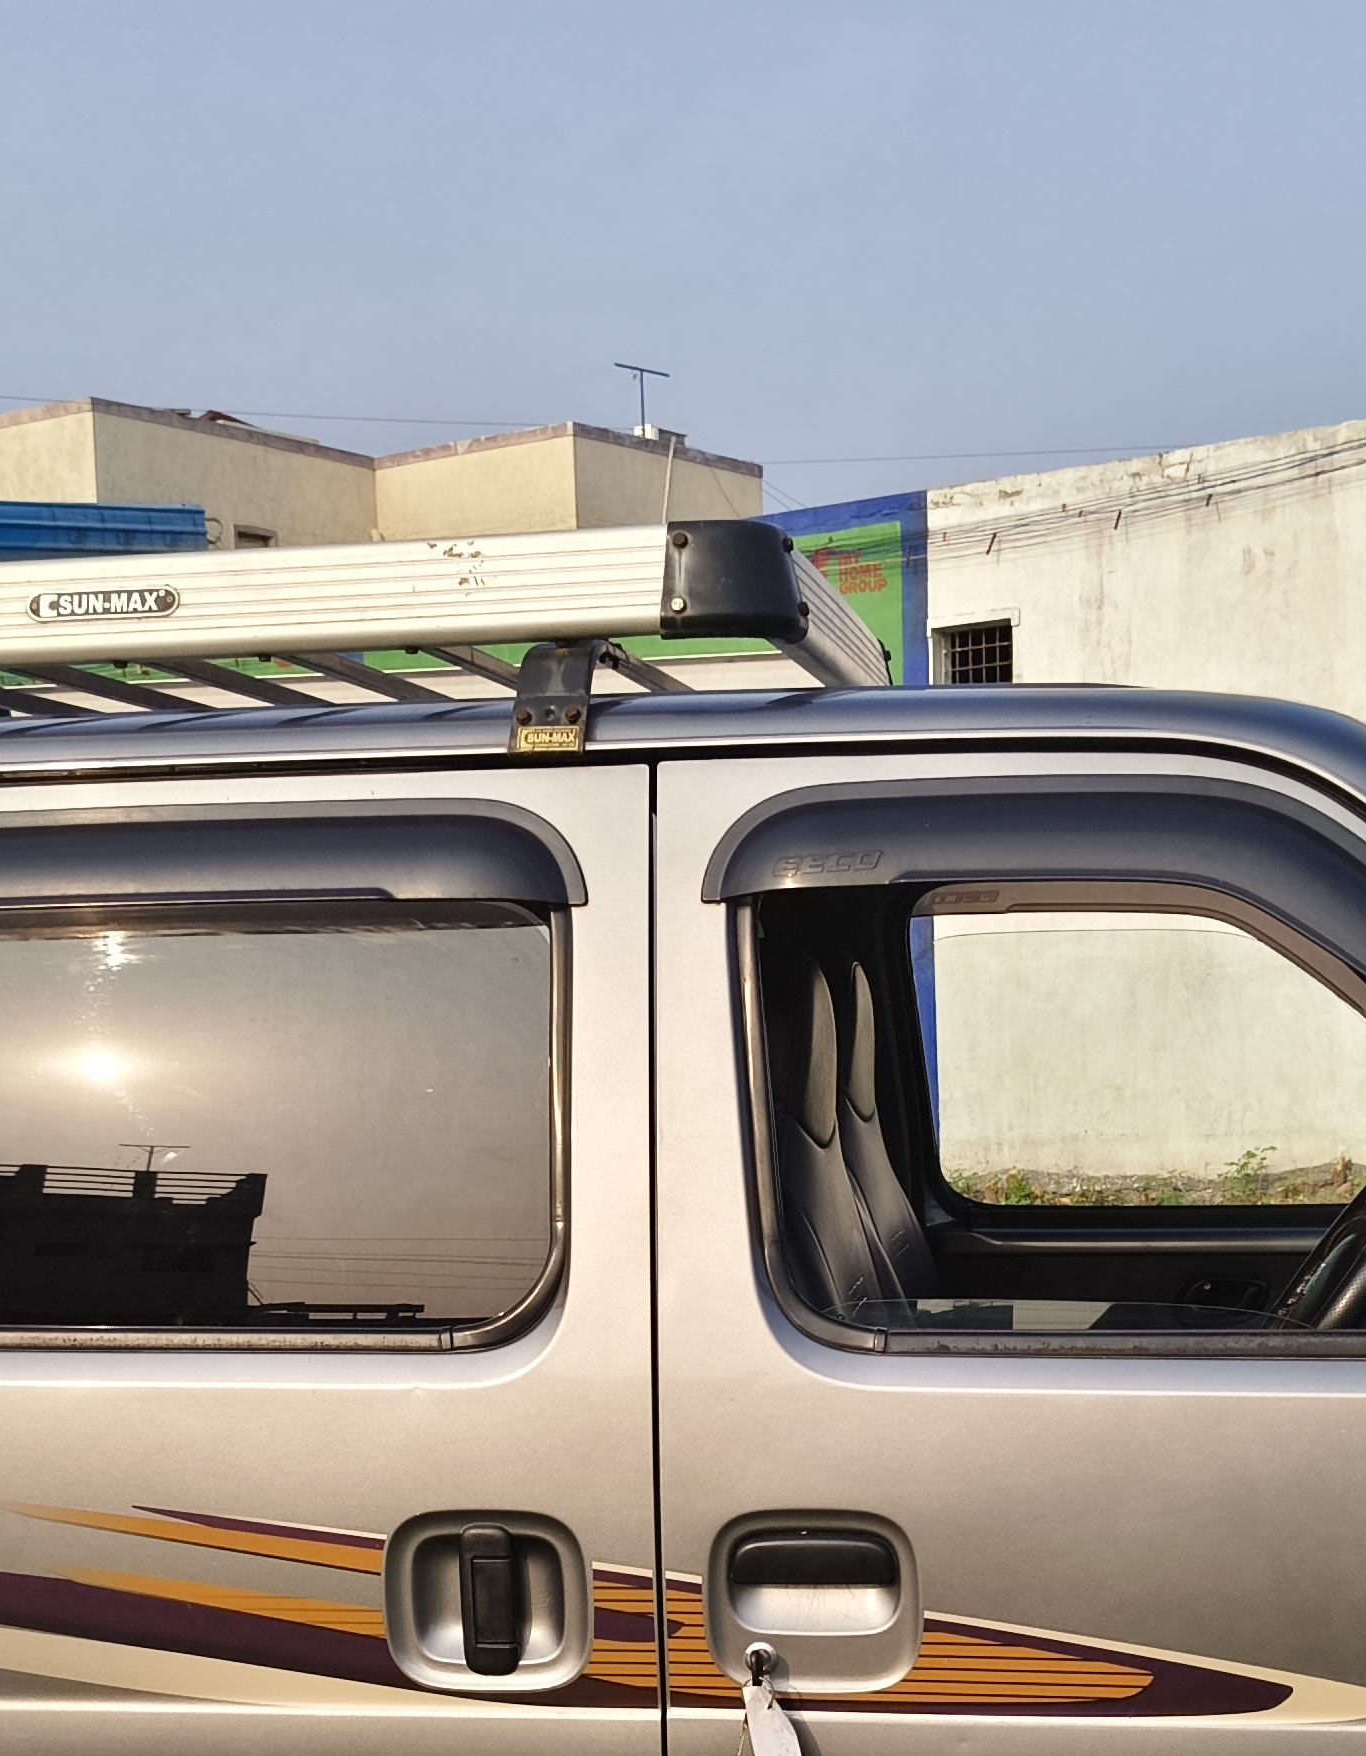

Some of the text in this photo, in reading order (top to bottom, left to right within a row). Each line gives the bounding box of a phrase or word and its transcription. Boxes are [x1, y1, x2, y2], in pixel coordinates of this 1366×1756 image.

[839, 577, 888, 595] GROUP
[58, 591, 158, 615] SUN-MAX
[772, 850, 884, 878] EECO
